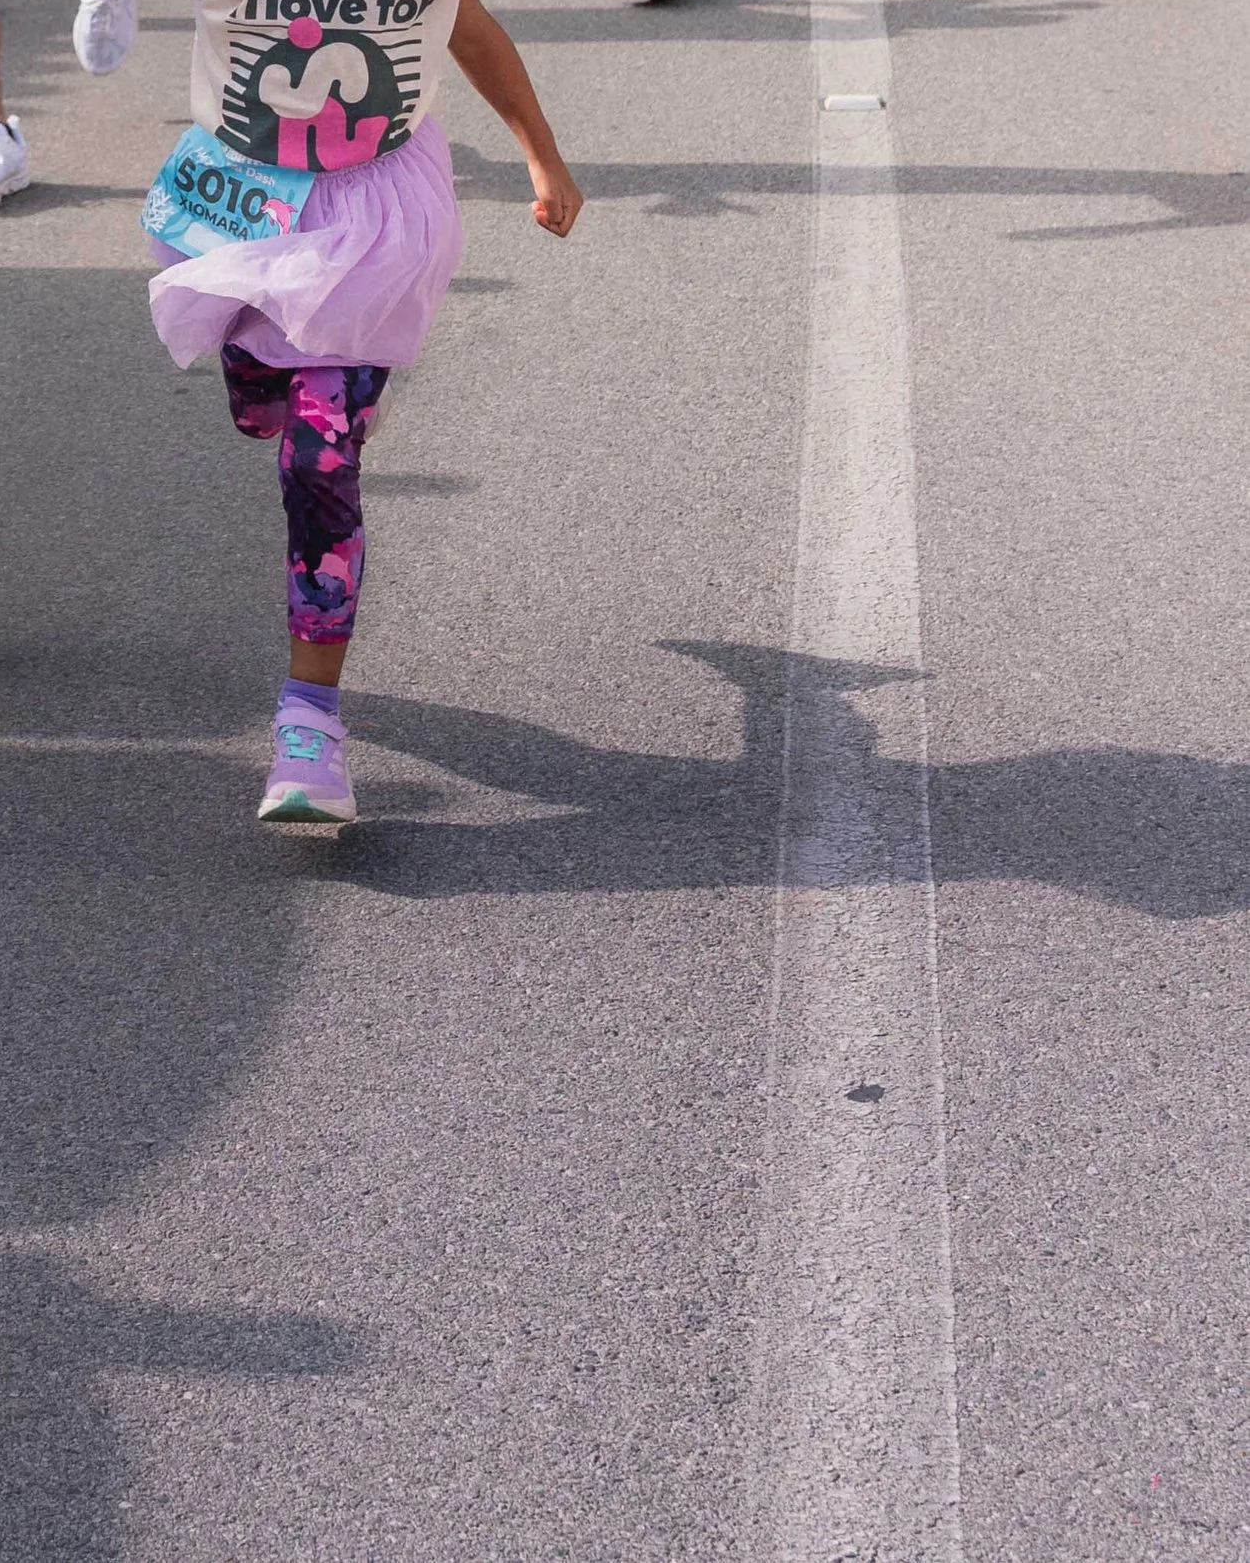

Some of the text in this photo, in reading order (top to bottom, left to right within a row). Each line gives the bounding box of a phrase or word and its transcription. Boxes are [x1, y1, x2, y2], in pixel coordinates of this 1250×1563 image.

[173, 157, 270, 224] 5010
[245, 167, 276, 188] Dash
[179, 194, 249, 242] XIOMARA
